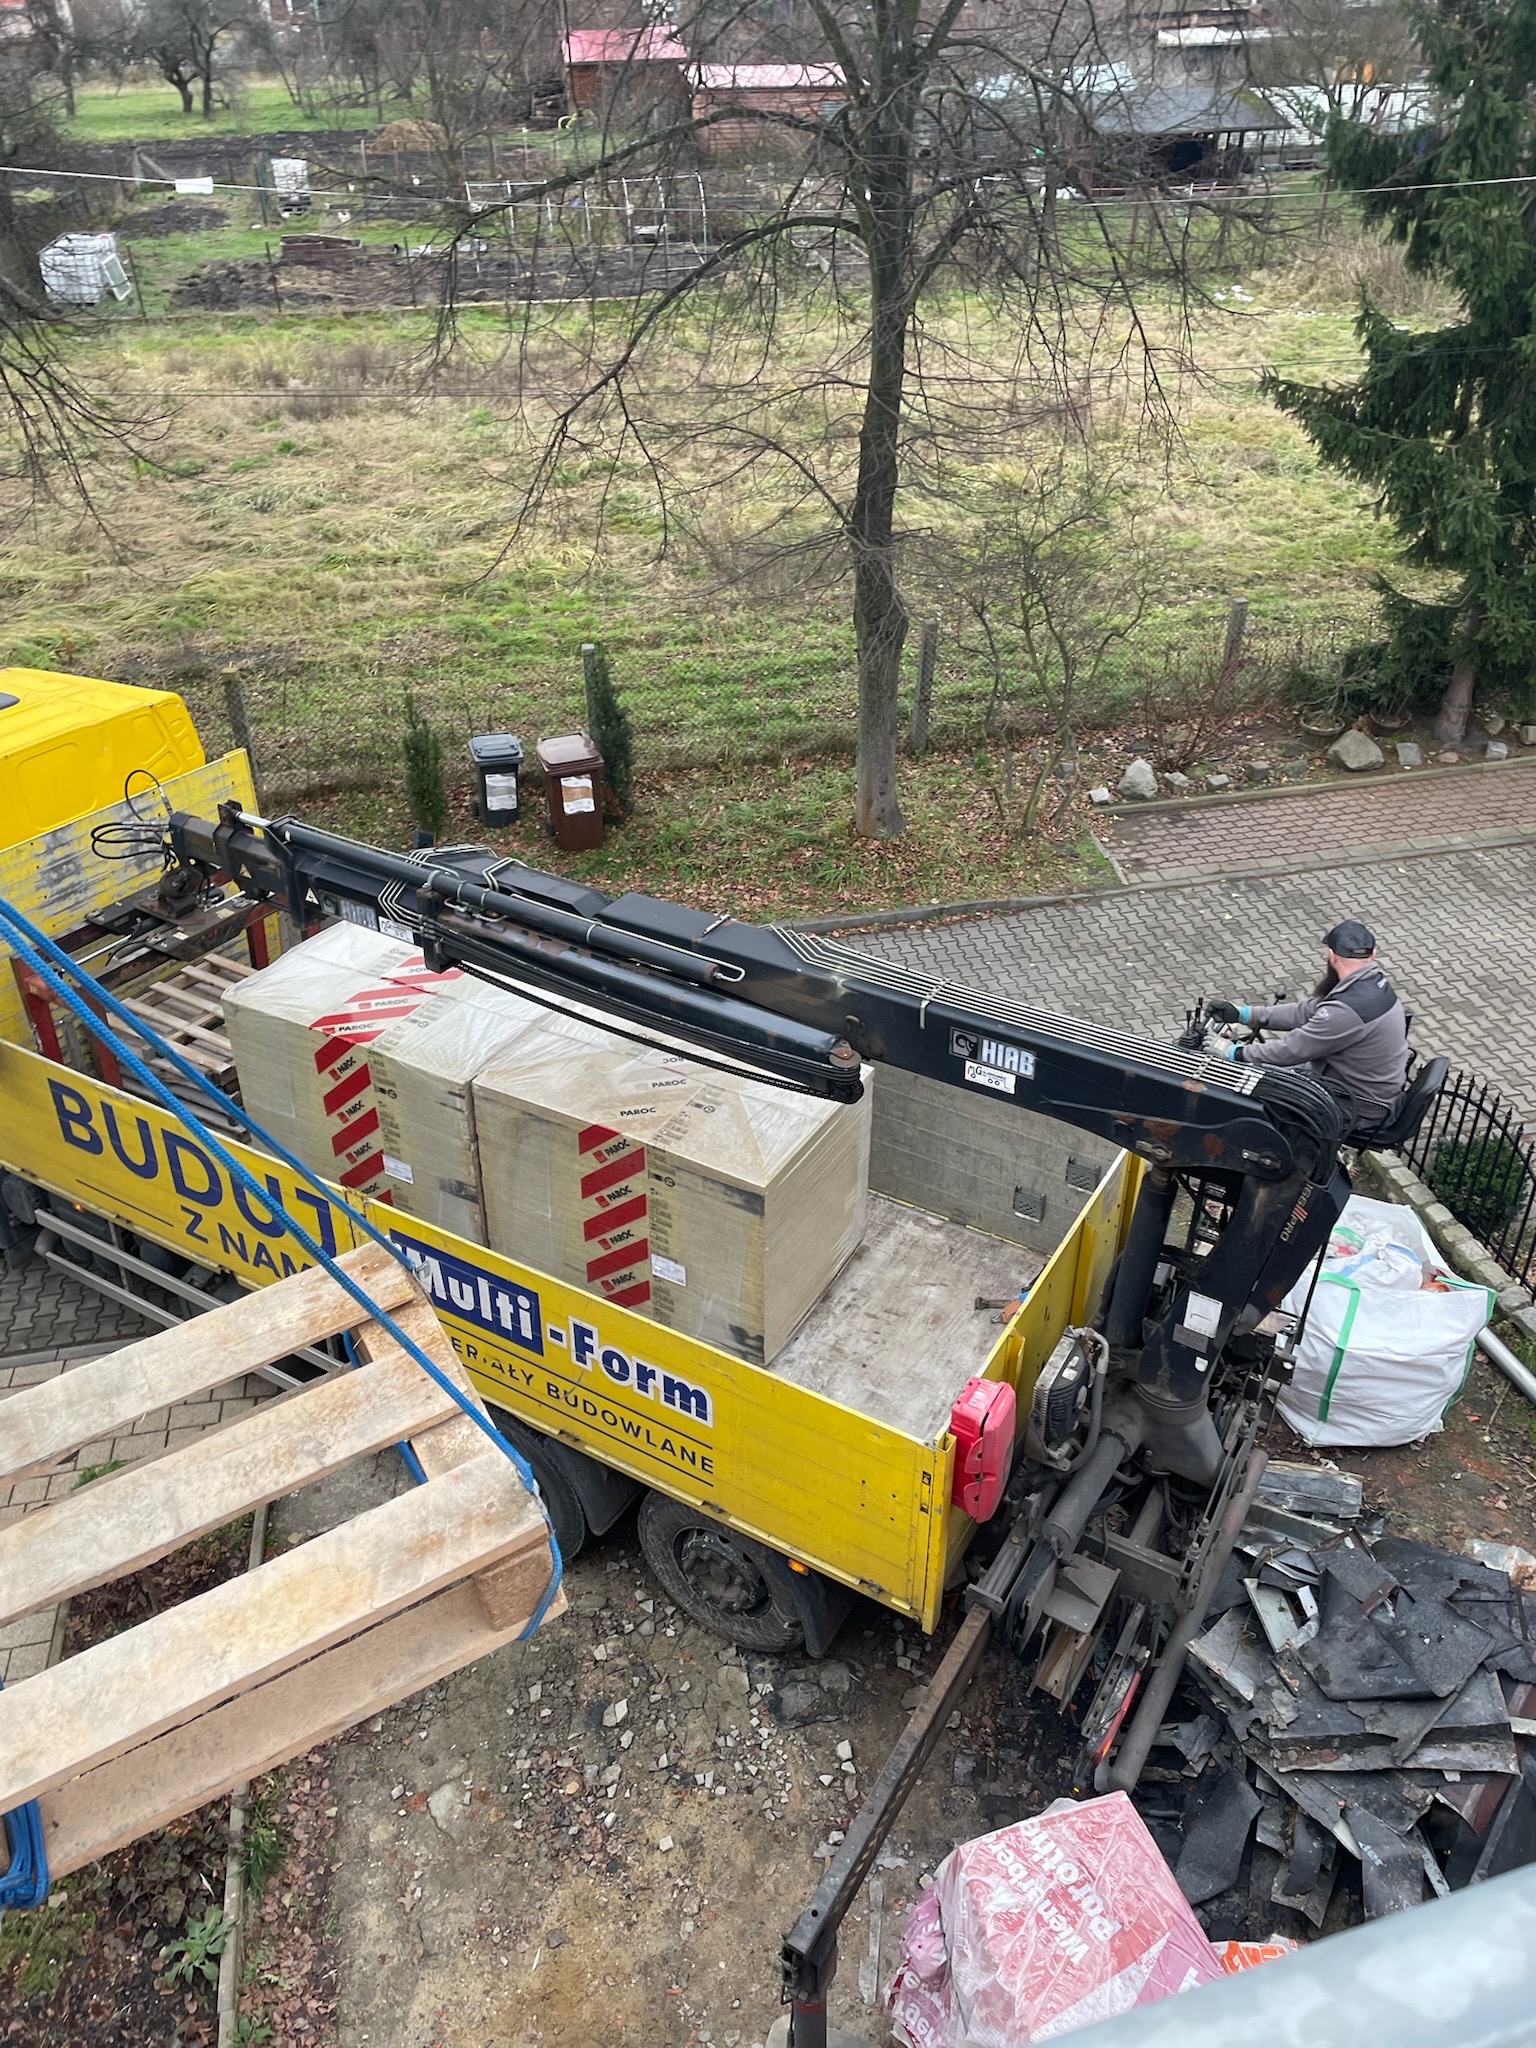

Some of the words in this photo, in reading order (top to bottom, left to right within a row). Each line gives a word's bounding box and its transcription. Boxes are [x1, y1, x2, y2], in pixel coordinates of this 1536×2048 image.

[338, 1023, 374, 1033] PAROC
[337, 1056, 357, 1074] PAROC
[981, 1038, 1035, 1076] HIAB
[651, 1078, 687, 1089] PAROC
[345, 1100, 365, 1118] PAROC
[619, 1106, 657, 1118] PAROC
[353, 1142, 373, 1159] PAROC
[604, 1138, 630, 1158] PAROC
[606, 1184, 632, 1203] PAROC
[180, 1205, 209, 1244] Z
[1279, 1213, 1299, 1242] PRO
[608, 1229, 634, 1246] PAROC
[611, 1271, 636, 1288] PAROC
[546, 1380, 715, 1476] BUDOWLANE
